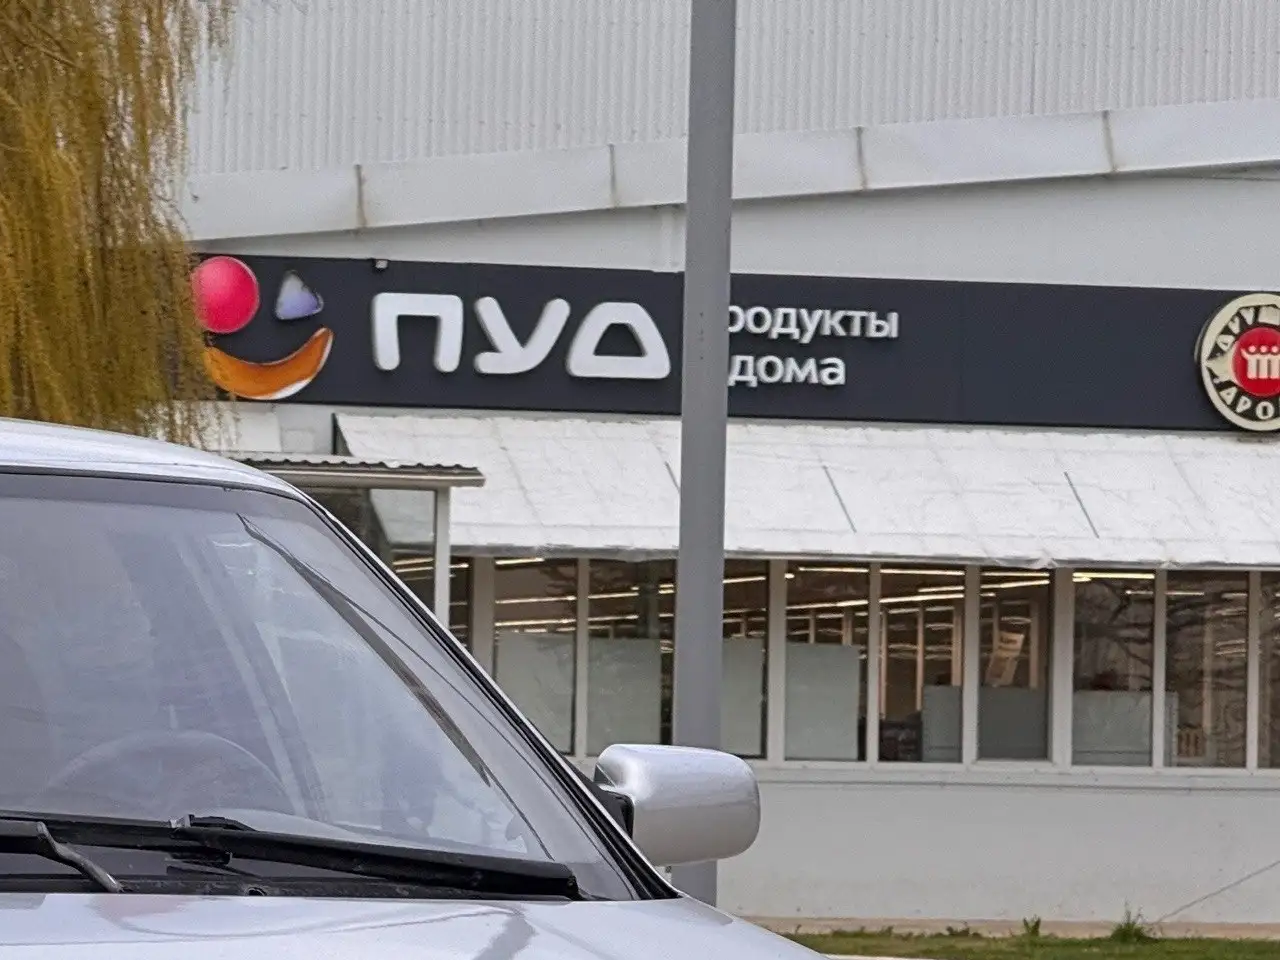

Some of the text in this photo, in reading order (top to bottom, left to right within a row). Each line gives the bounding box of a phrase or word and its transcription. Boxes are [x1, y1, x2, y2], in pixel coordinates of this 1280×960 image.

[371, 292, 672, 379] ПУД
[728, 305, 899, 344] родукты
[727, 355, 846, 388] дома
